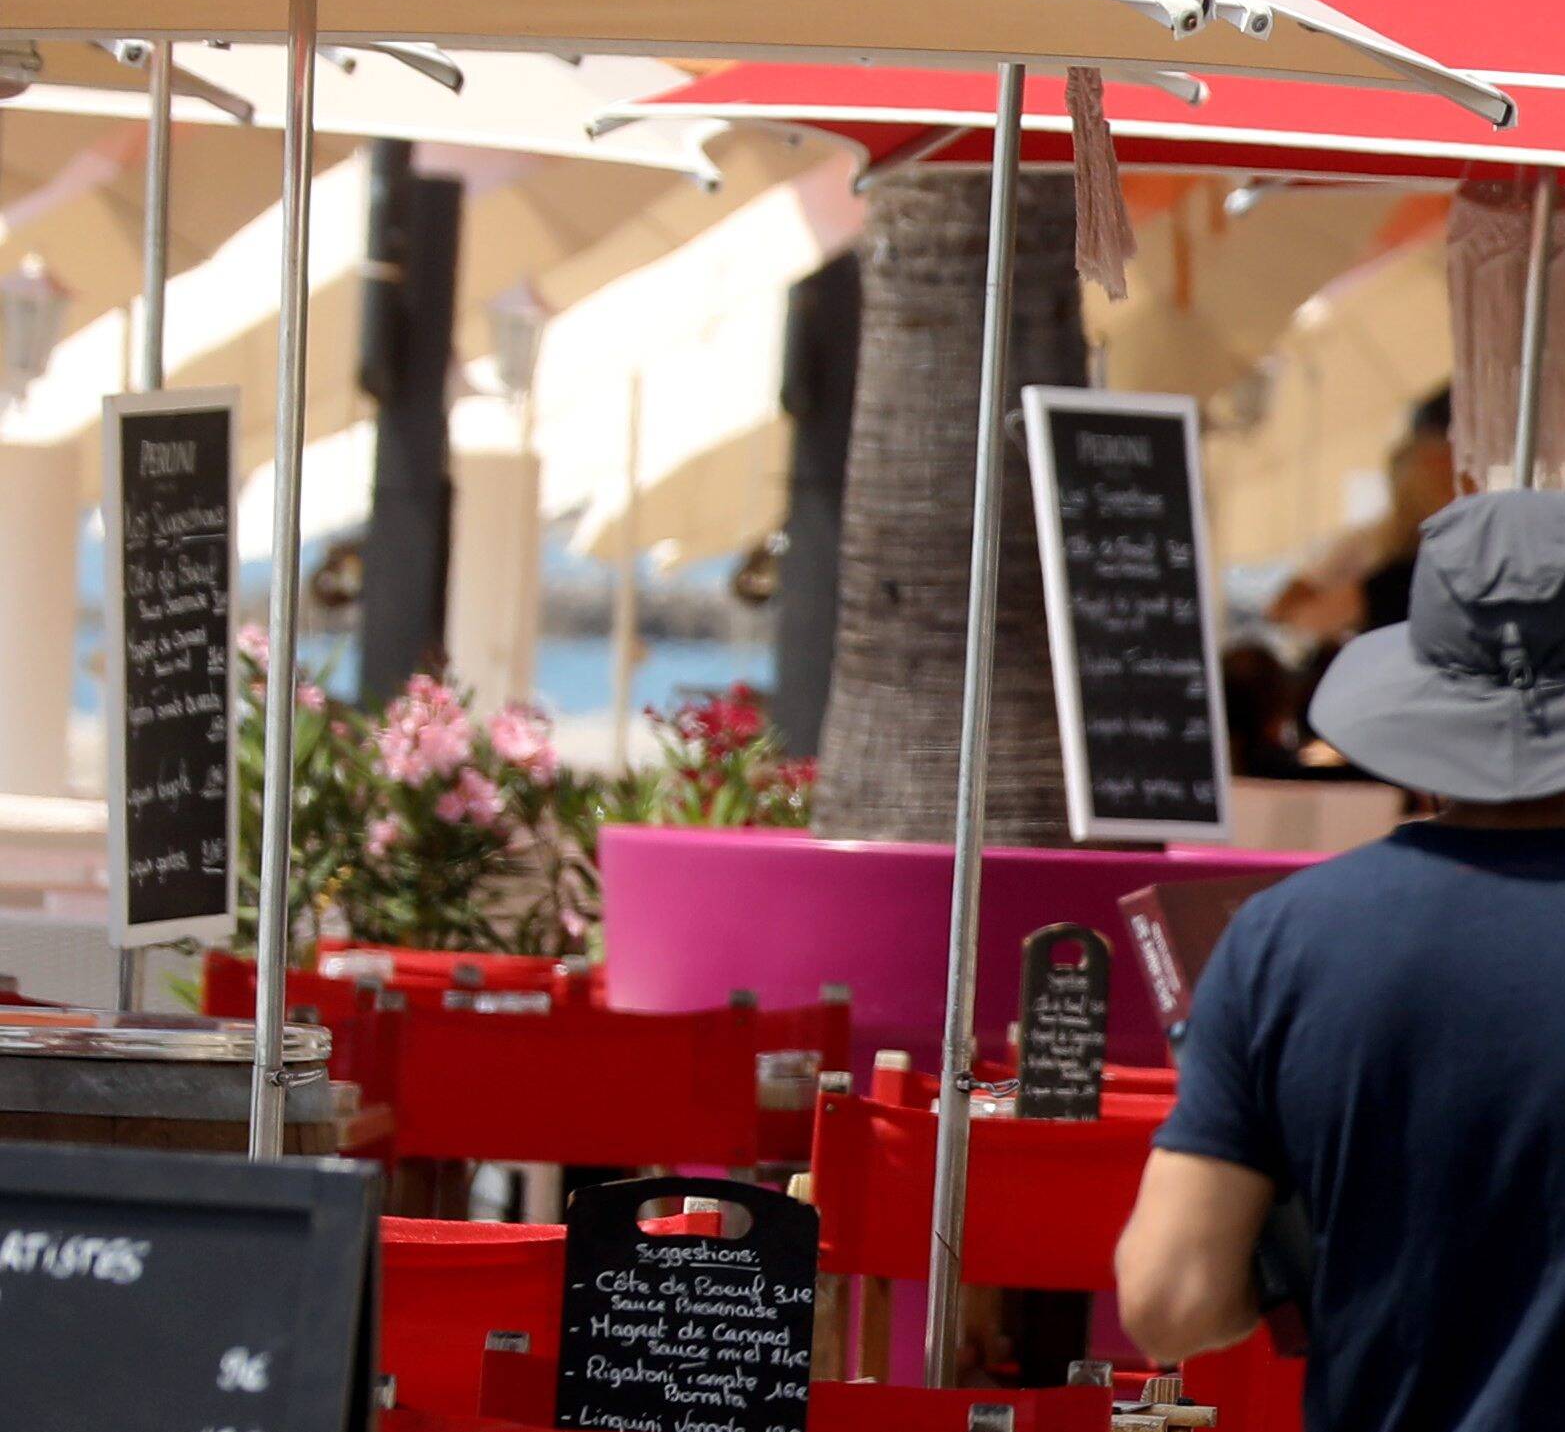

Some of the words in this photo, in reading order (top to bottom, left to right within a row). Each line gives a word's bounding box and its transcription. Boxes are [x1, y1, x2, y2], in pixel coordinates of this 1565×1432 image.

[595, 1268, 651, 1294] Côte
[659, 1274, 690, 1296] de
[678, 1317, 706, 1340] de
[712, 1323, 790, 1346] Canard
[586, 1354, 674, 1387] Rigatoni
